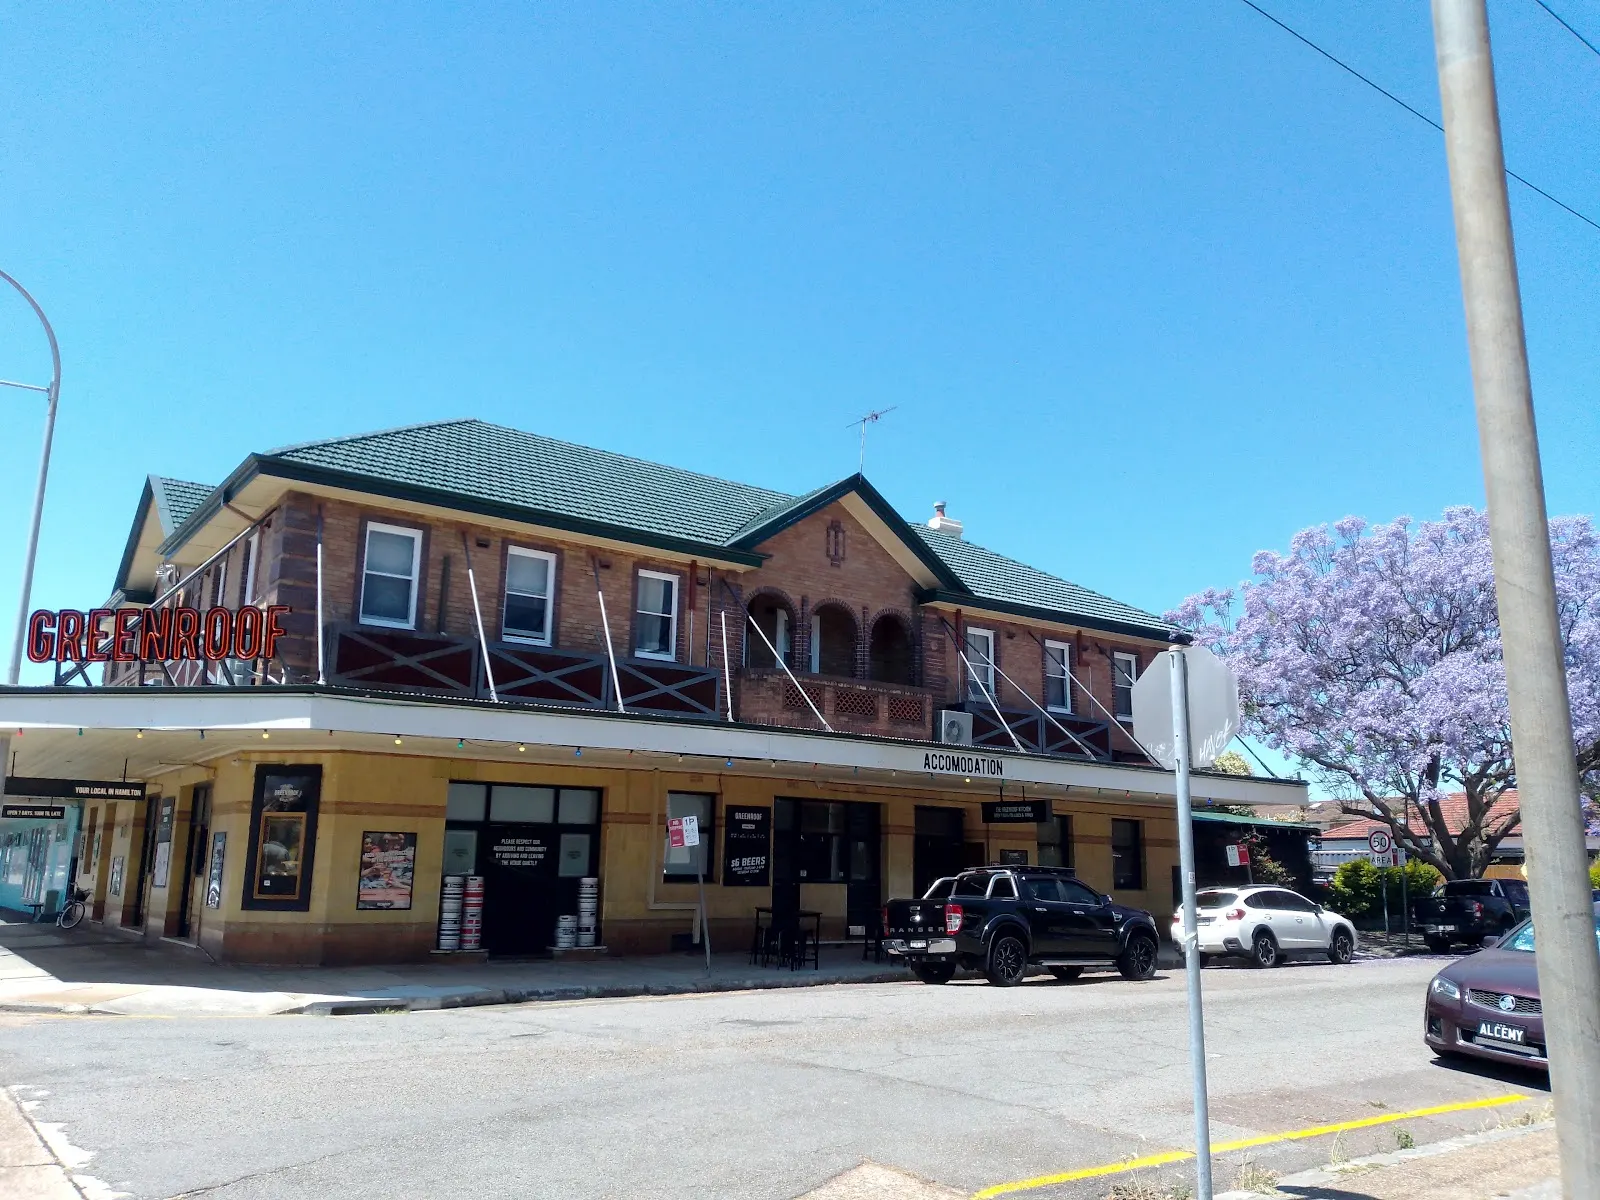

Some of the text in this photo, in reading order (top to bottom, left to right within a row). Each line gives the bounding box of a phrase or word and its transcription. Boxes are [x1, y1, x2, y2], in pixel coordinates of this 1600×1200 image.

[27, 606, 292, 663] GREENROOF
[923, 753, 1003, 775] ACCOMODATION
[75, 786, 141, 796] YOUR LOCAL IN HAMILTON
[734, 812, 762, 820] GREENROOF
[1373, 837, 1387, 848] 50
[741, 856, 765, 866] BEERS
[1371, 856, 1391, 864] AREA
[1480, 1023, 1524, 1041] ALCEMY
